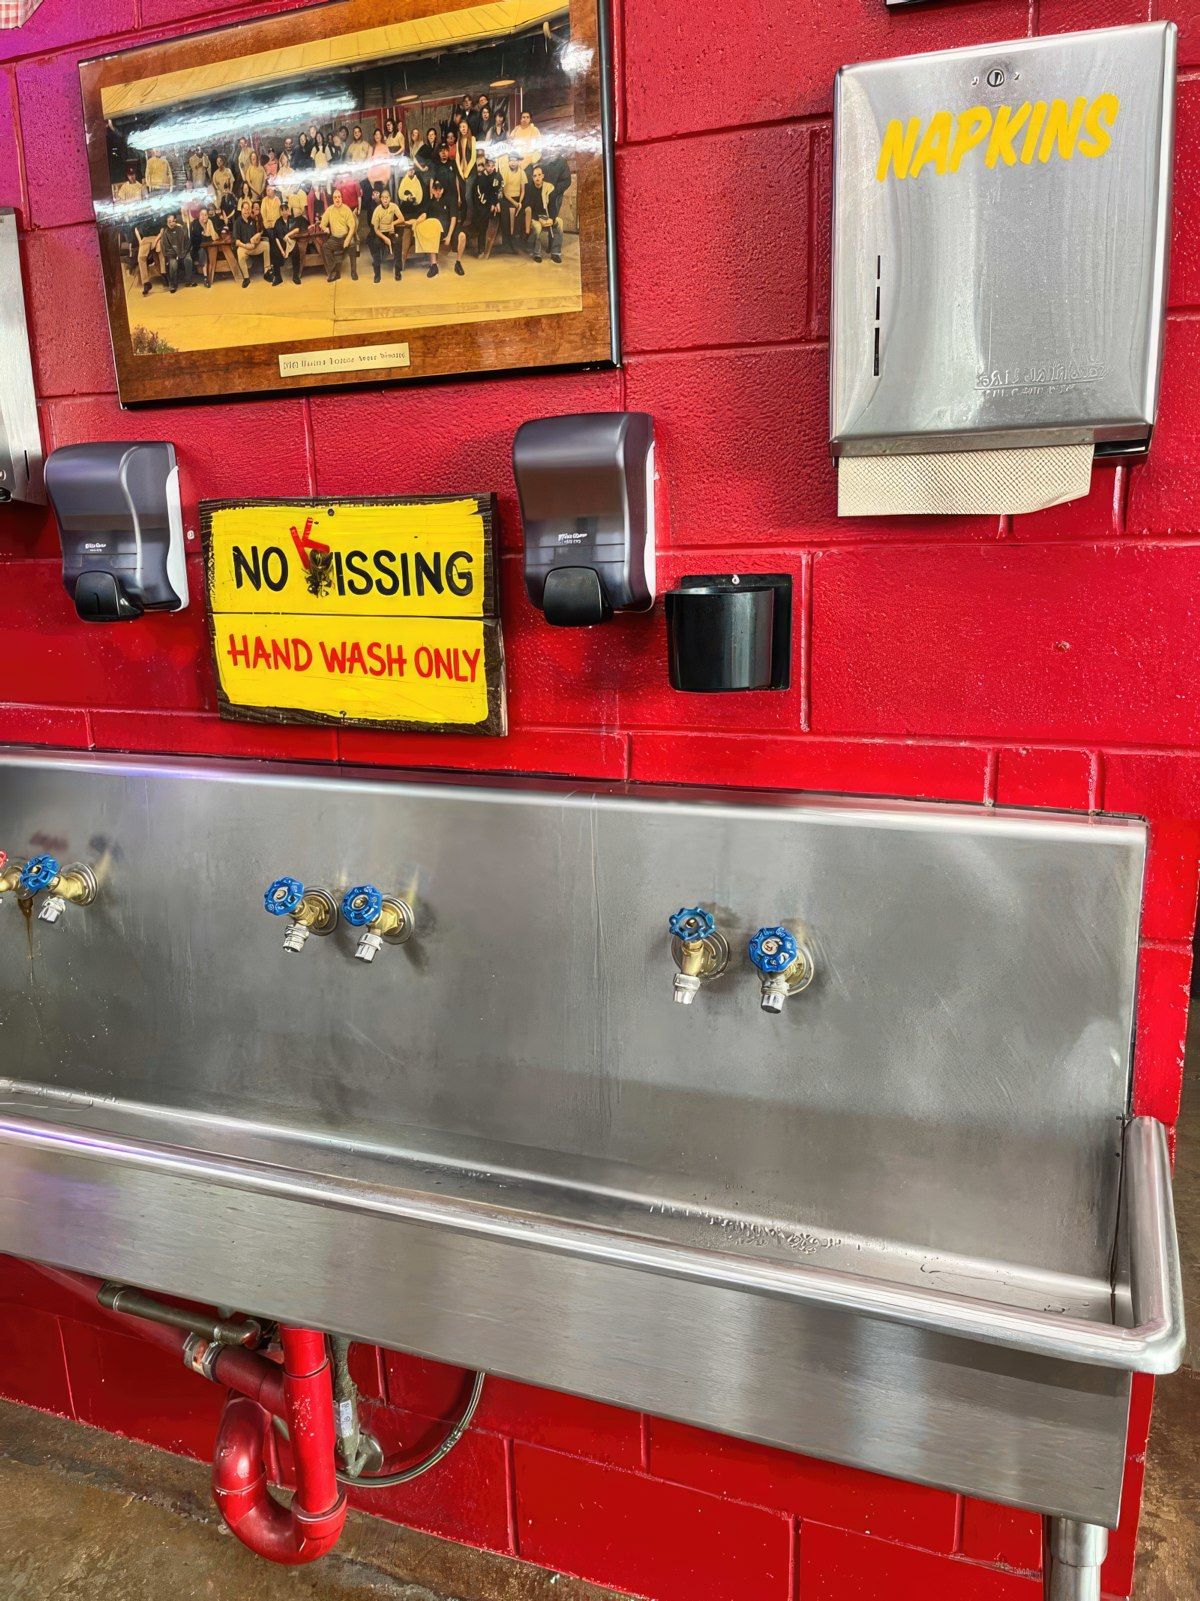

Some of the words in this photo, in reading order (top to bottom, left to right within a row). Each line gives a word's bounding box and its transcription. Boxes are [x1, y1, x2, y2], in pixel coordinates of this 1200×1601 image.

[876, 93, 1120, 183] NAPKINS
[232, 546, 289, 592] NO
[289, 517, 474, 597] KISSING
[227, 634, 313, 672] HAND
[319, 641, 407, 677] WASH
[414, 646, 481, 683] ONLY
